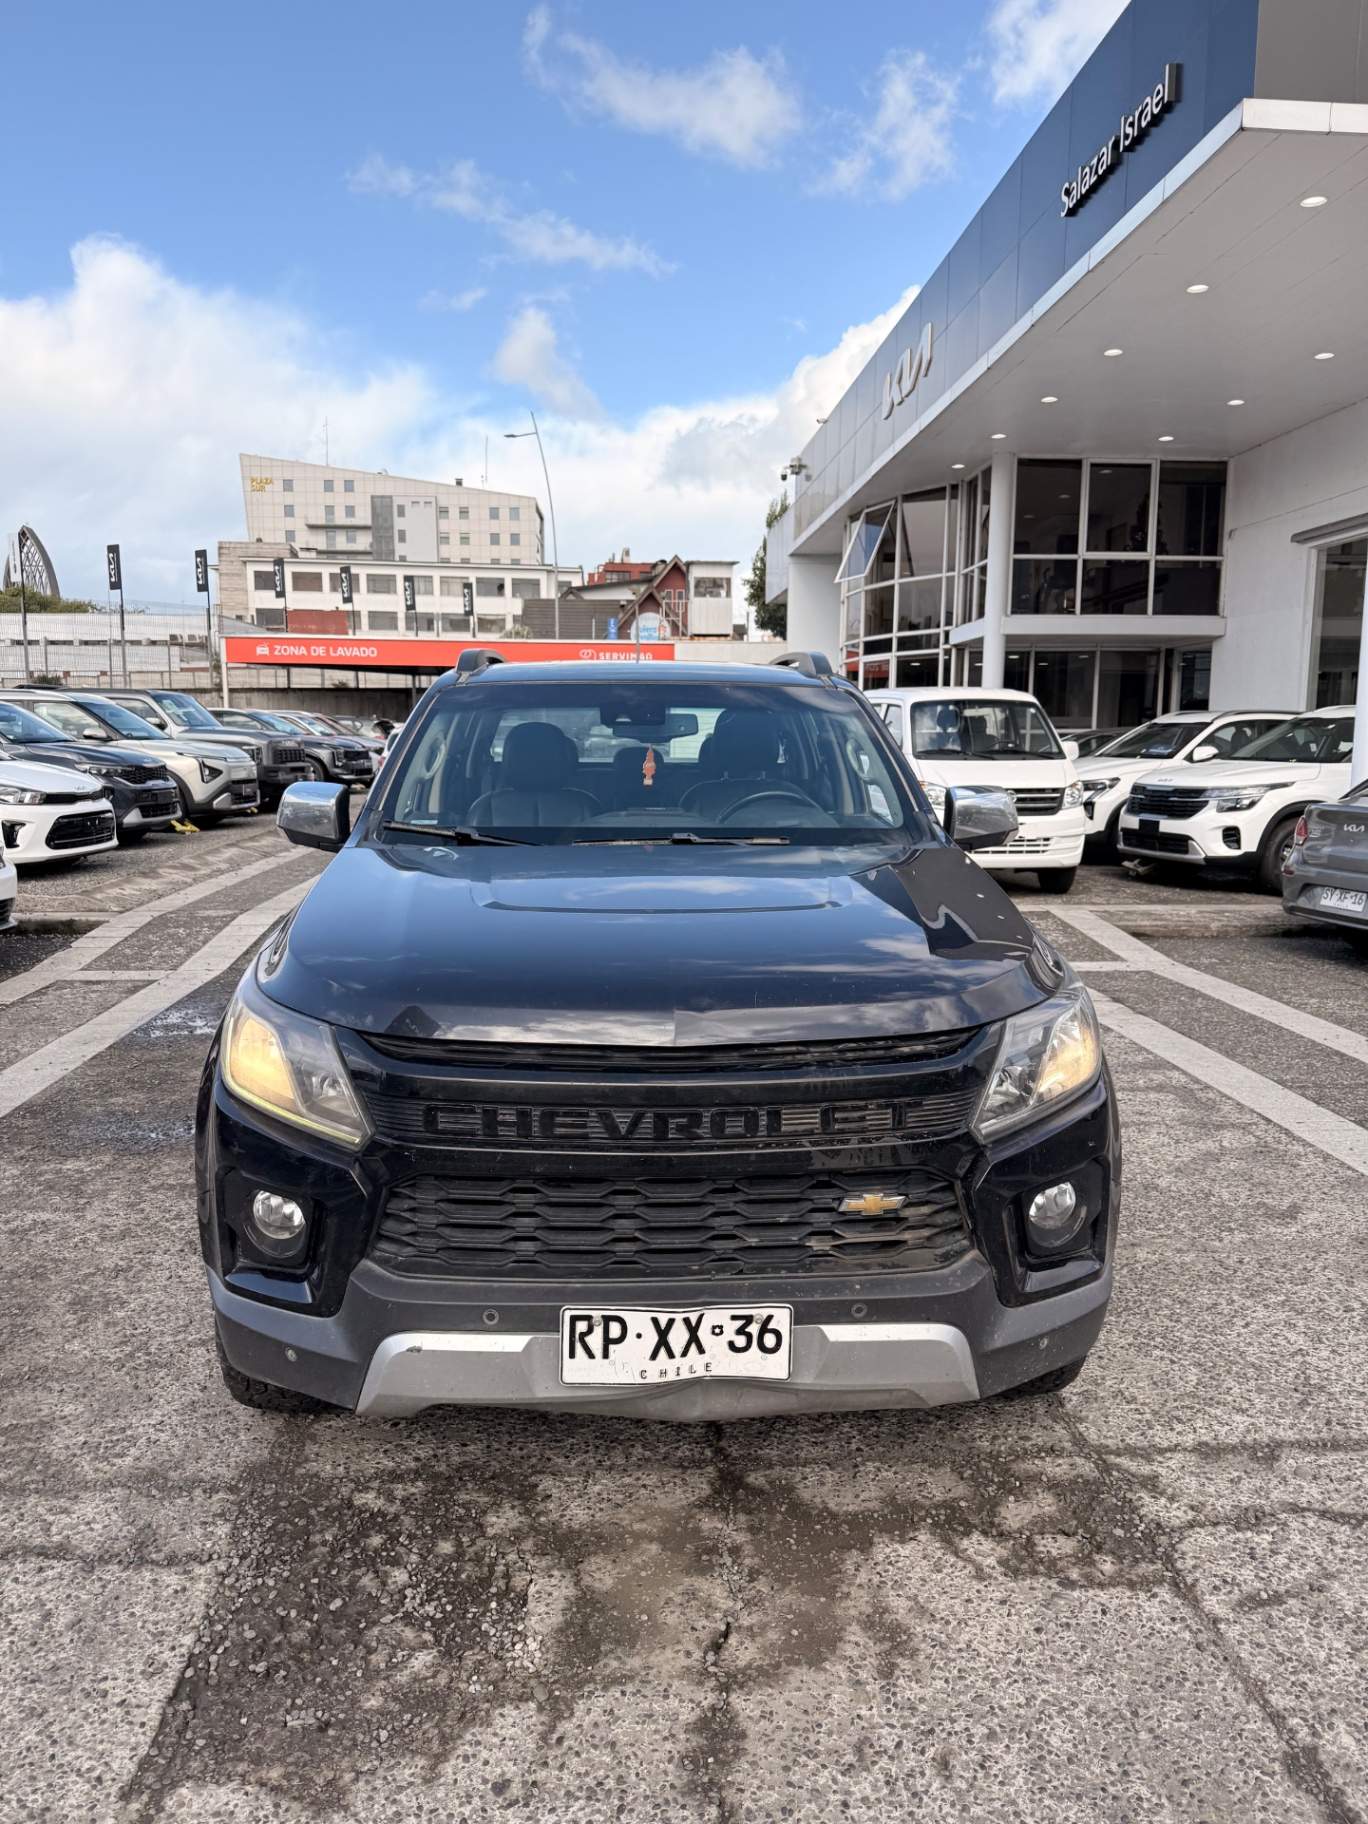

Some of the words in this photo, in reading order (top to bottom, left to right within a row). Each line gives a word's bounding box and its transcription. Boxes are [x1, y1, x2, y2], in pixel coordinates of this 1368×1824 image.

[1061, 134, 1119, 217] Salazar
[1120, 63, 1178, 152] Israel
[882, 322, 933, 420] KIA
[273, 645, 308, 656] ZONA
[311, 646, 326, 656] DE
[329, 646, 378, 658] LAVADO
[1343, 823, 1365, 833] KIA
[422, 1101, 923, 1141] CHEVROLET
[639, 1361, 713, 1380] CHILE
